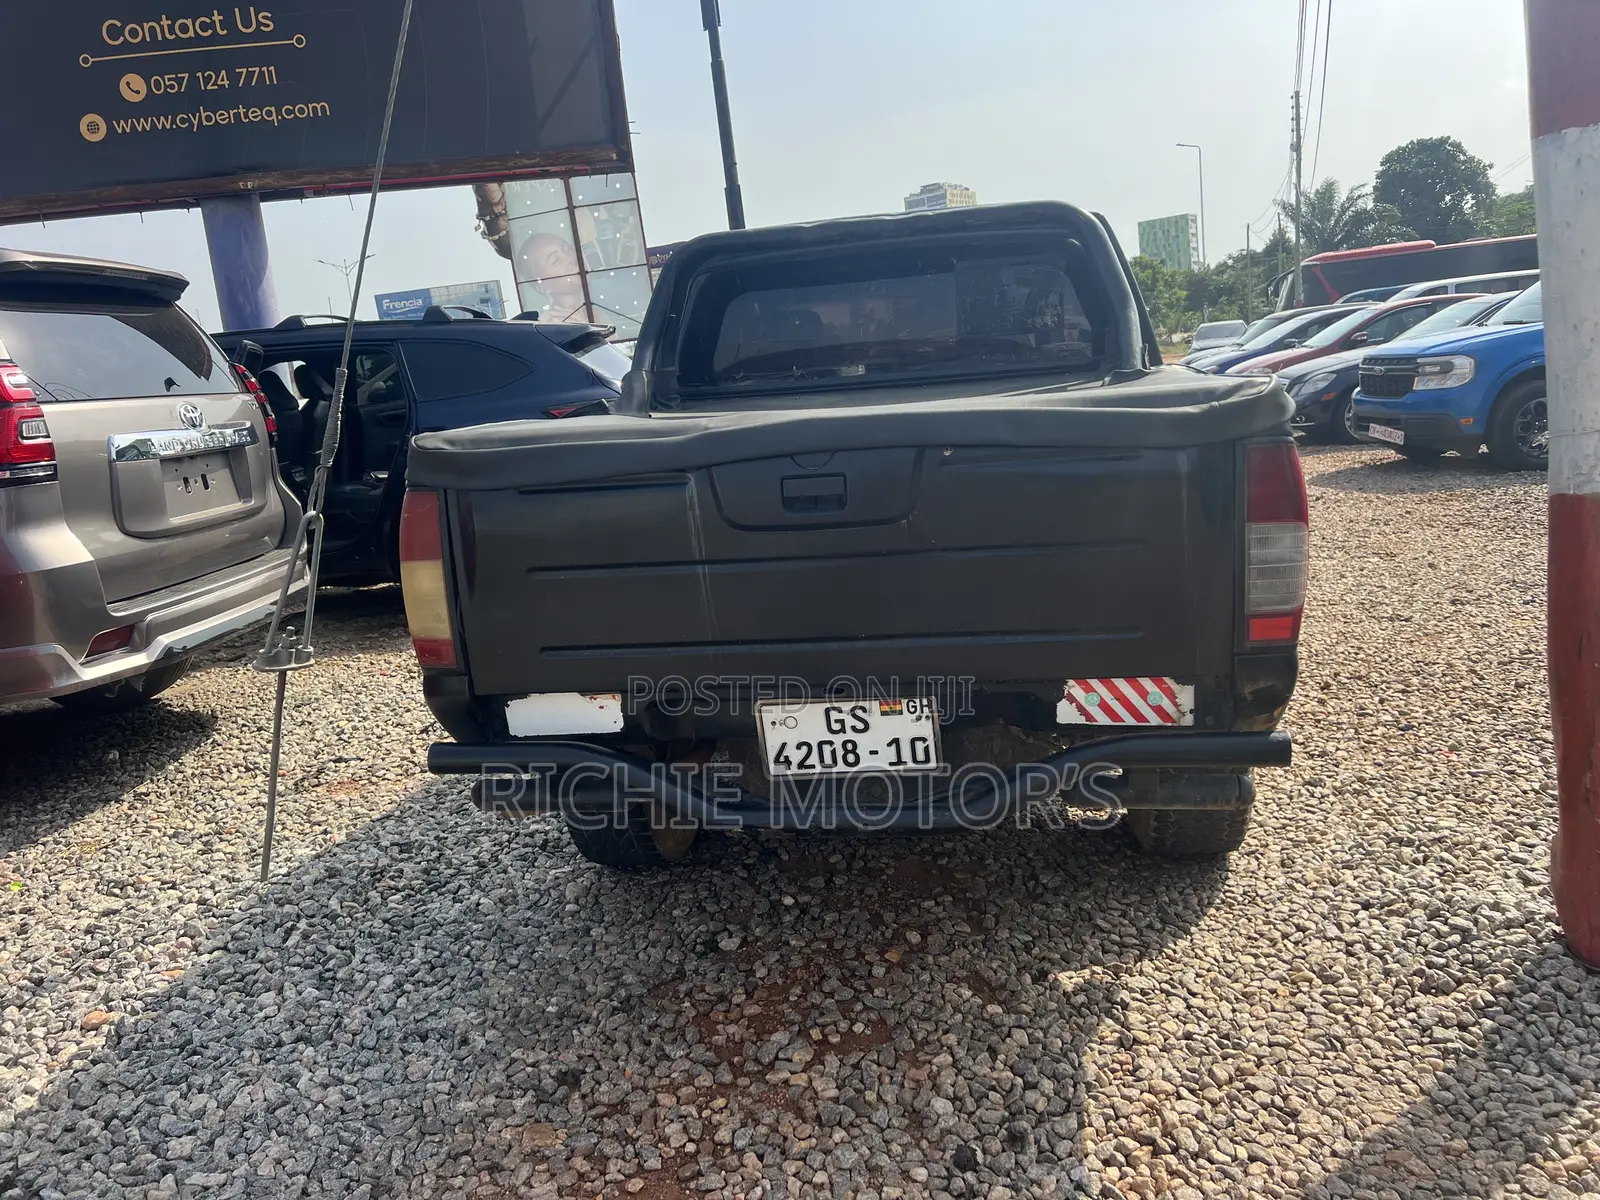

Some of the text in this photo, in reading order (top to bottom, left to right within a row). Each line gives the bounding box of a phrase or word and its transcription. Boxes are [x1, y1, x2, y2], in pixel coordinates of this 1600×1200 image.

[102, 6, 275, 46] Contact Us
[150, 65, 277, 95] 057 124 7711
[112, 101, 331, 132] www.cyberteq.com
[382, 297, 423, 311] Frencia
[824, 699, 932, 735] GS GH
